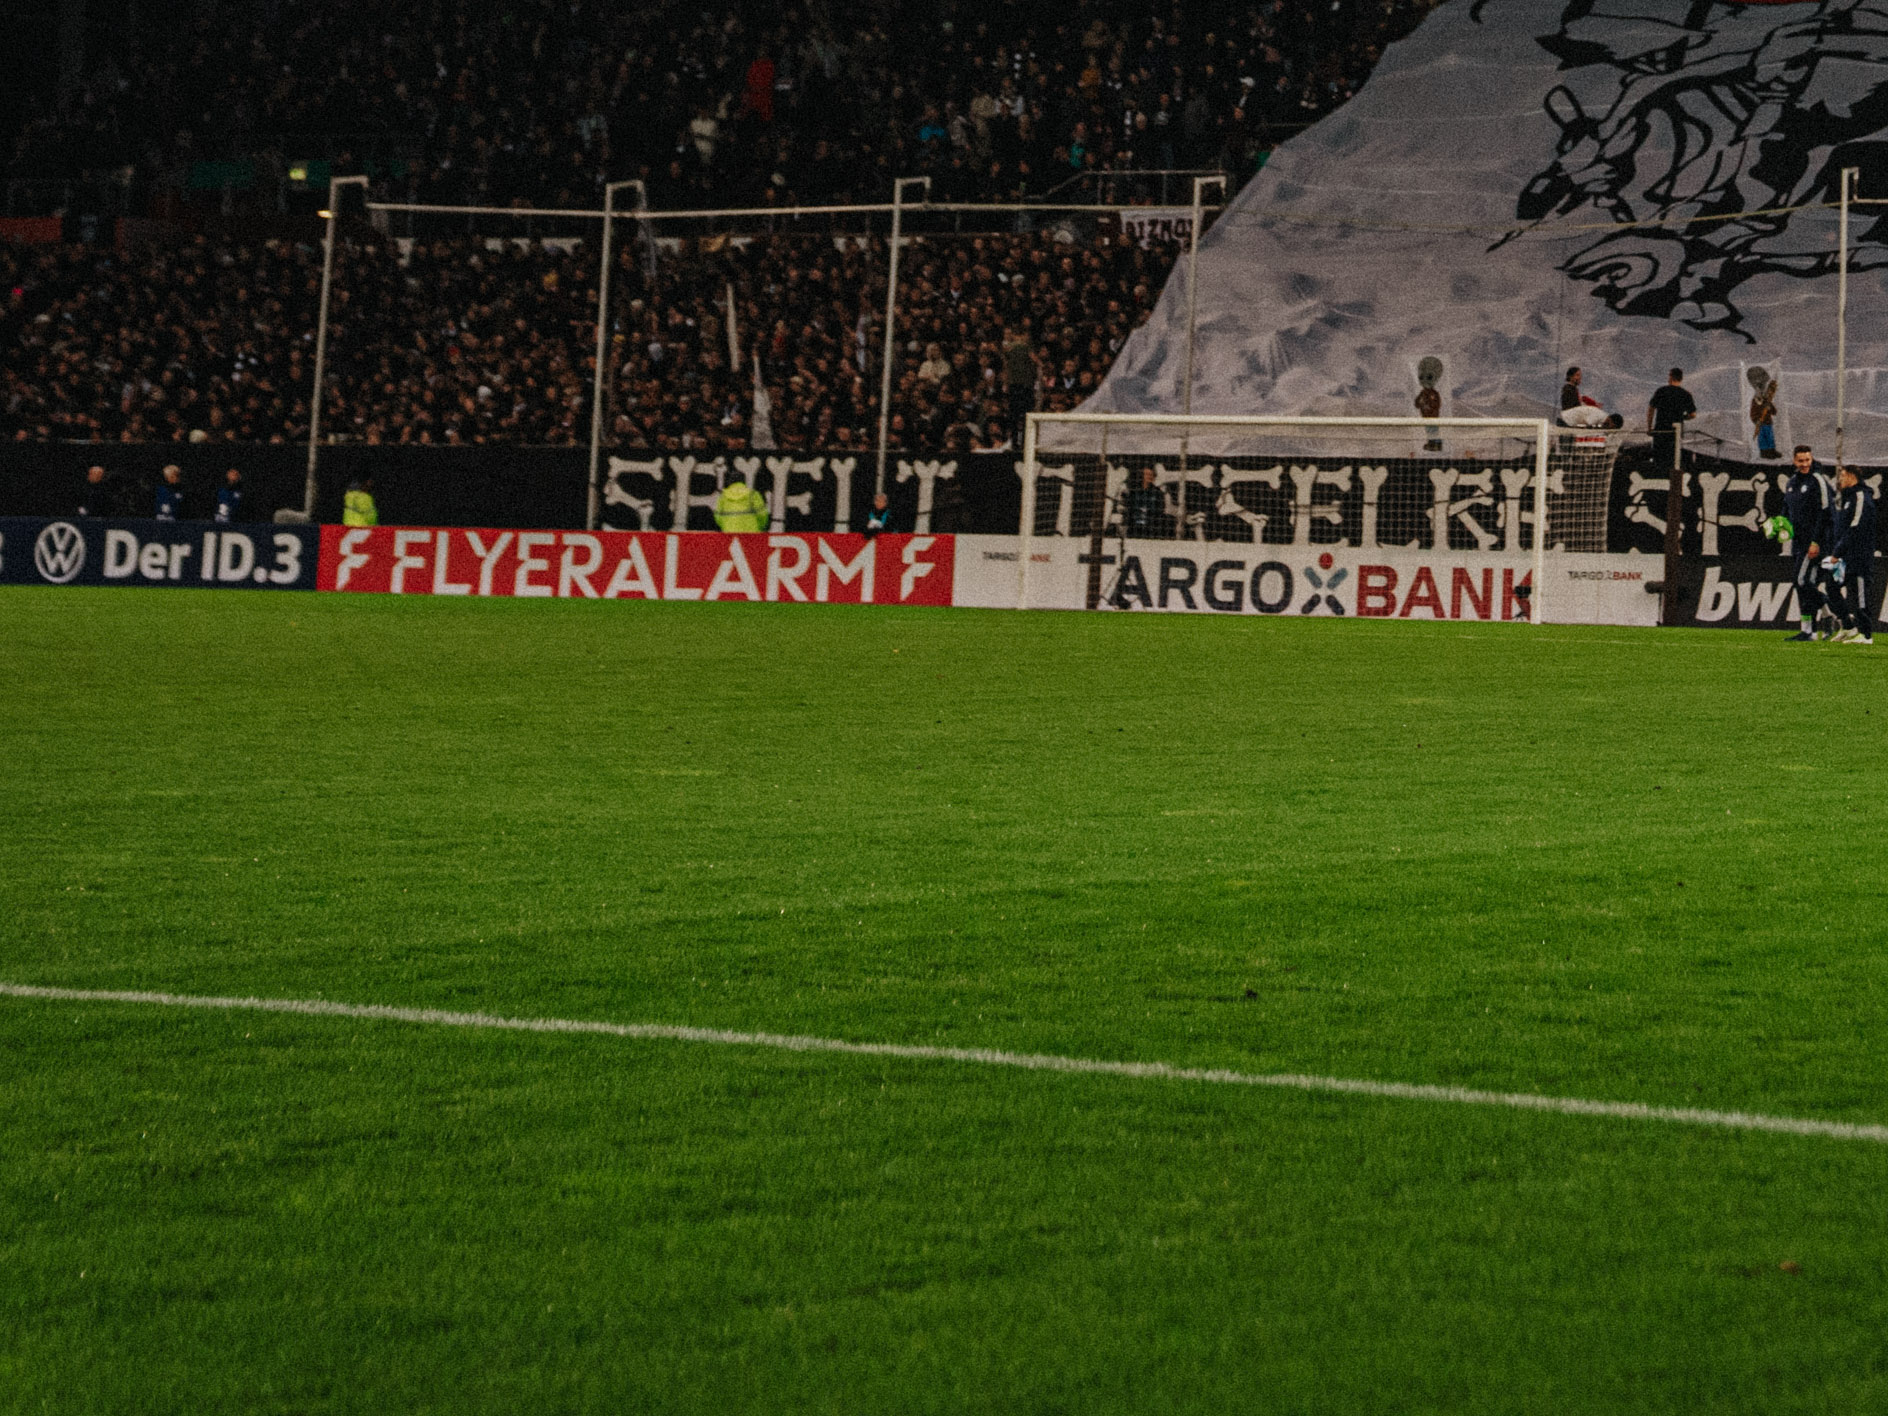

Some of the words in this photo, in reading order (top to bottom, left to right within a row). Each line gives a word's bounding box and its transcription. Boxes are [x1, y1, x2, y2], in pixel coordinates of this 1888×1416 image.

[103, 529, 192, 580] Der
[201, 531, 302, 584] ID.3
[389, 529, 876, 602] FLYERALARM
